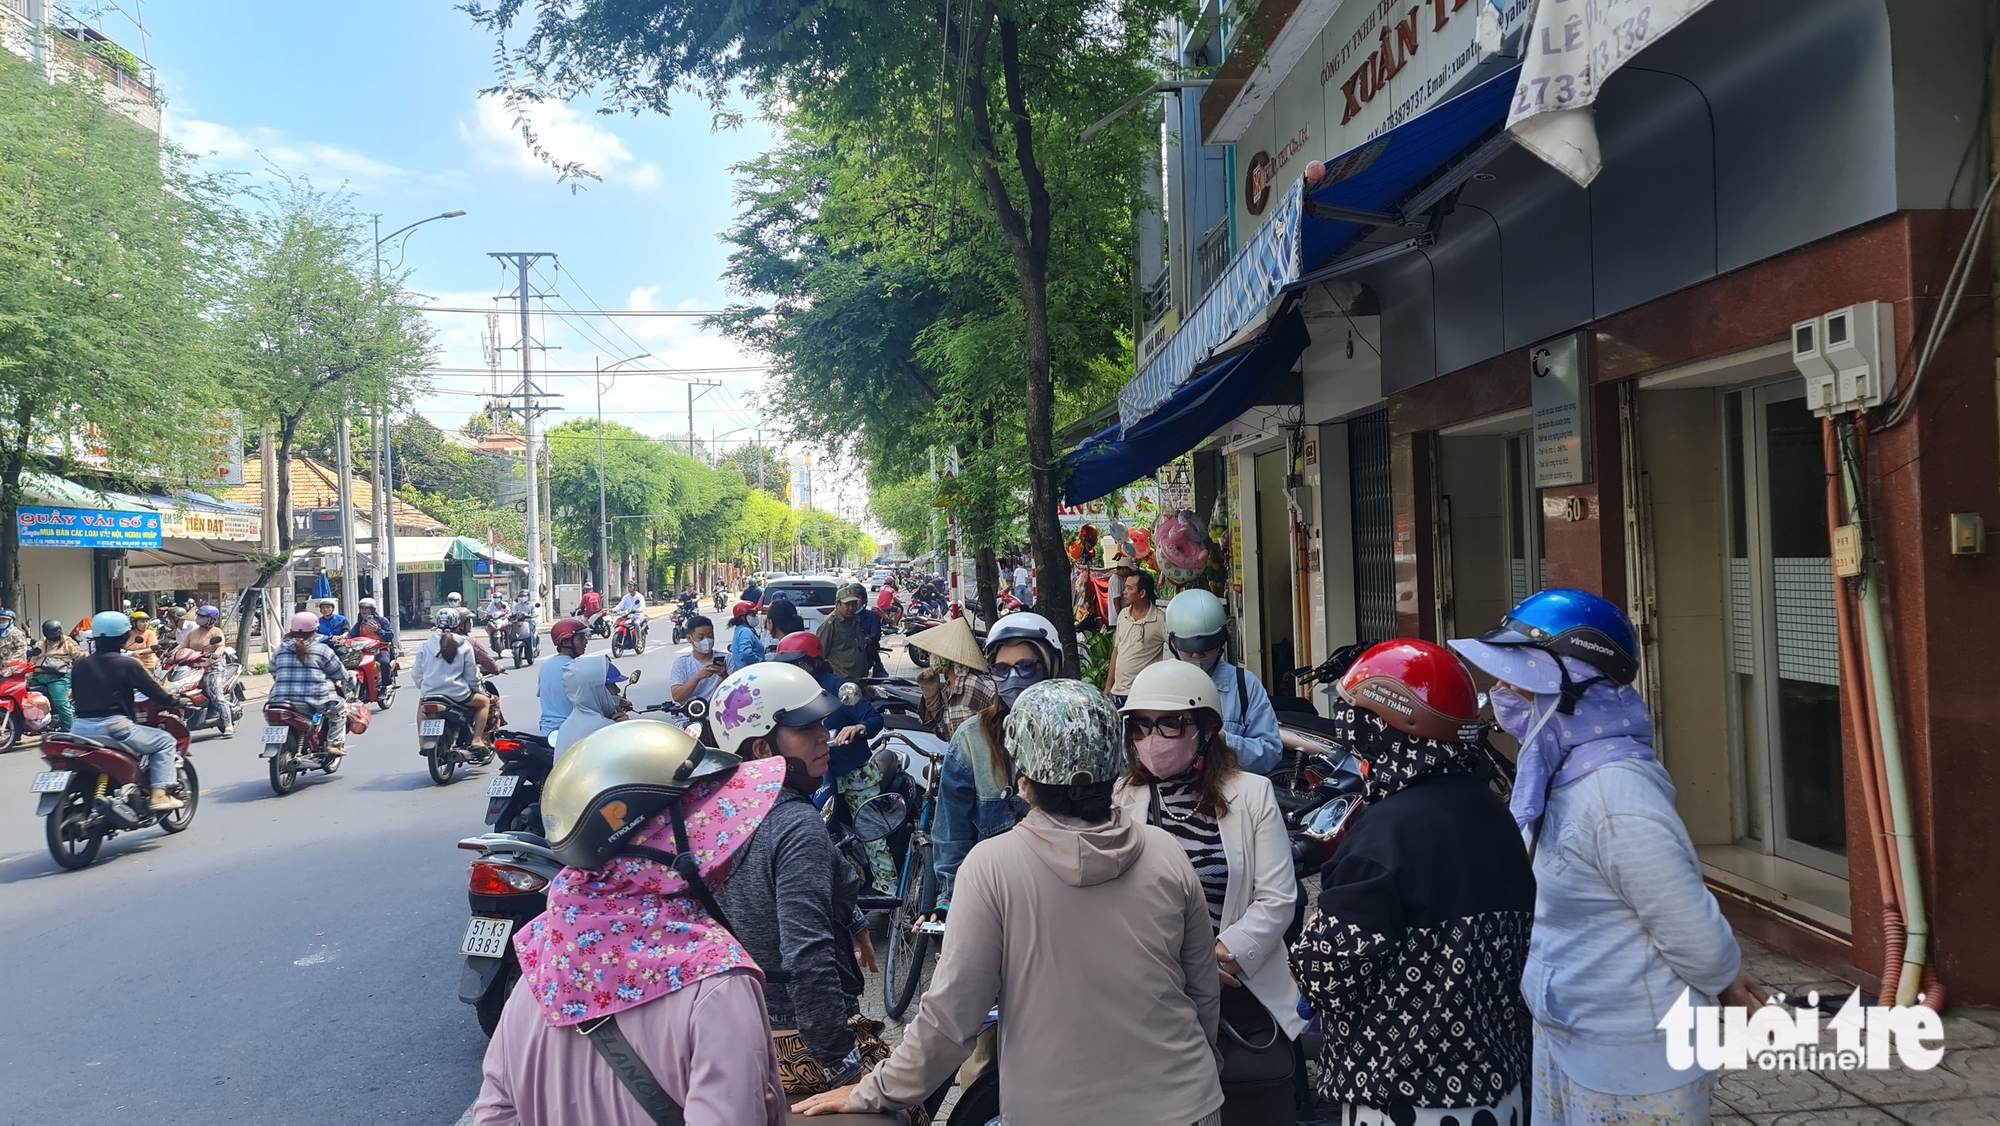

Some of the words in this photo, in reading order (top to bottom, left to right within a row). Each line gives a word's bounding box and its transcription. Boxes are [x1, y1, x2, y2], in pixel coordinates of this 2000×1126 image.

[1541, 13, 1584, 56] LÊ
[1320, 53, 1341, 87] CÔNG
[1340, 39, 1353, 65] TY
[1351, 9, 1377, 51] TNHH
[1340, 5, 1420, 126] XUÂN
[20, 510, 76, 526] QUẦY
[81, 513, 114, 527] VẢI
[120, 514, 143, 528] SỐ
[147, 519, 158, 529] 5
[1566, 497, 1581, 522] 60
[40, 528, 55, 536] MUA
[56, 528, 70, 537] BÁN
[71, 528, 83, 537] CÁC
[207, 518, 224, 537] ĐẠT
[1570, 636, 1615, 657] vinaphone
[1362, 688, 1386, 704] HUỲNH
[1386, 699, 1413, 716] THÀNH
[607, 815, 646, 843] PETROLIMEX
[467, 937, 500, 954] 0383
